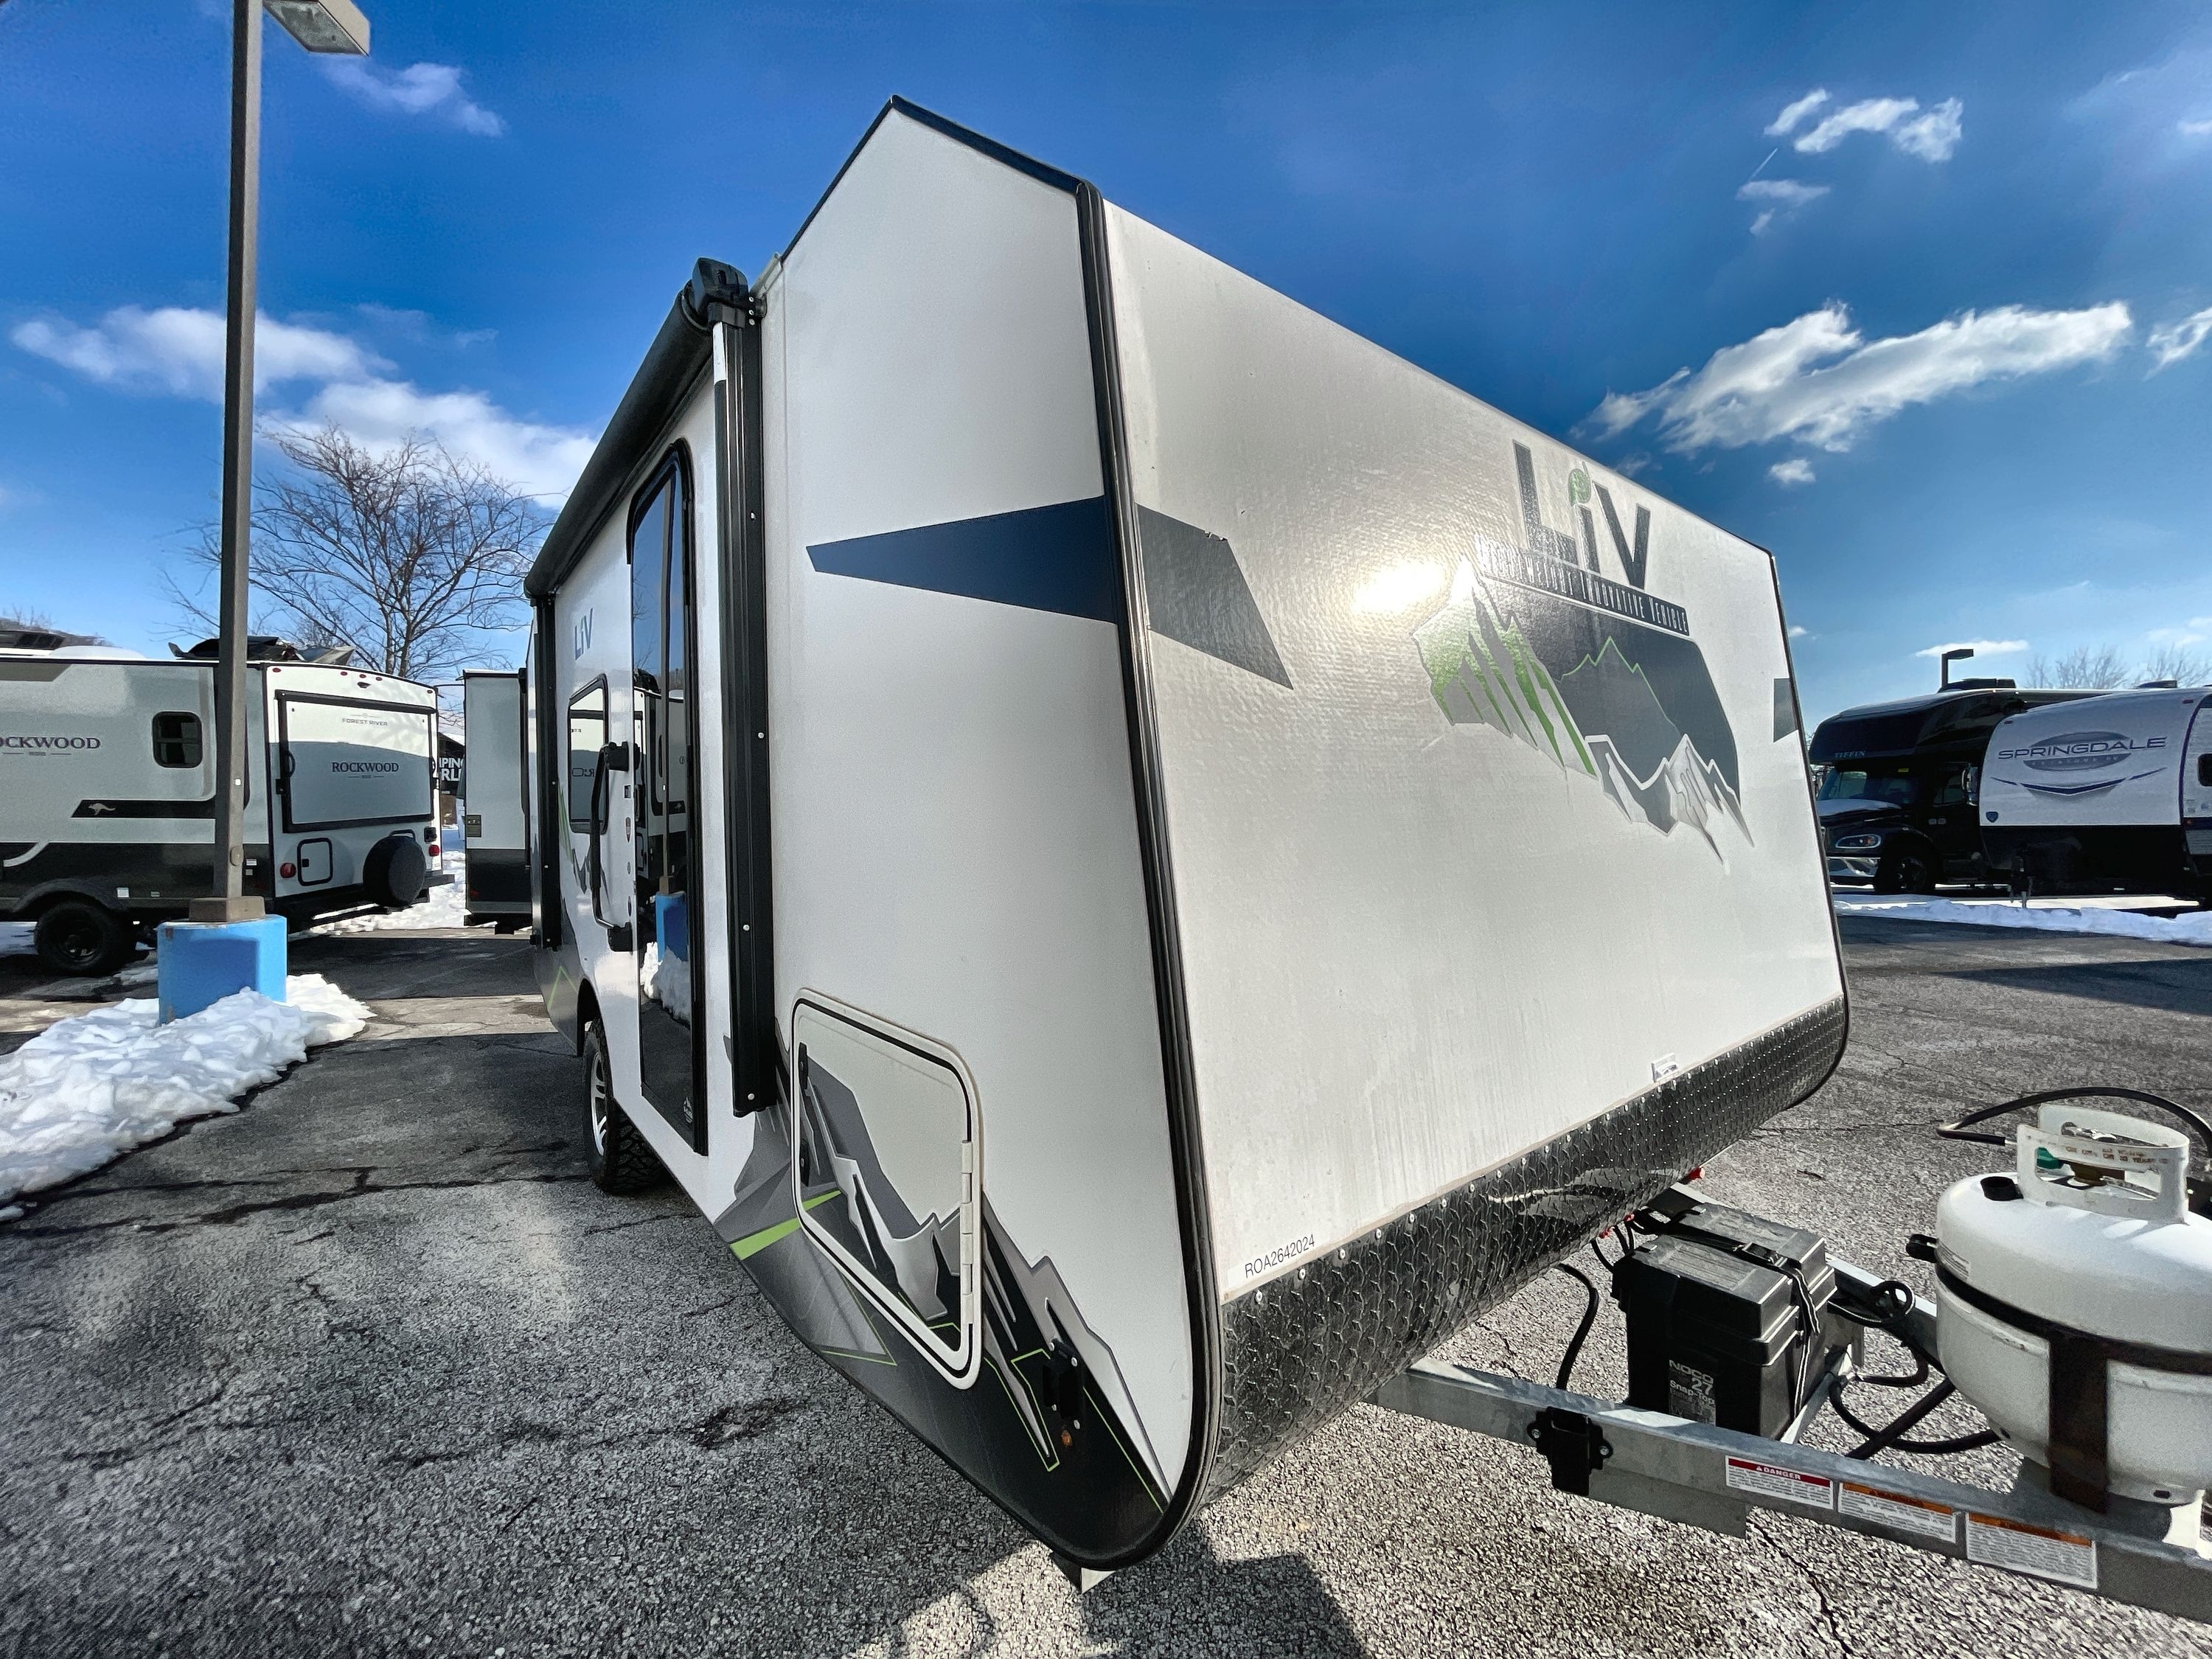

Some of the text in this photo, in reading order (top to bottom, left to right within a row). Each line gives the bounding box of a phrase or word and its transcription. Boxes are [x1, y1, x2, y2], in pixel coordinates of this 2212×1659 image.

[342, 717, 368, 726] FOREST
[0, 737, 101, 749] CKWOOD
[1998, 737, 2168, 760] SPRINGDALE
[331, 762, 399, 773] ROCKWOOD
[1245, 1234, 1315, 1279] ROA2642024
[1669, 1360, 1714, 1384] NOCO
[1691, 1377, 1713, 1396] 27
[1763, 1466, 1801, 1481] DANGER
